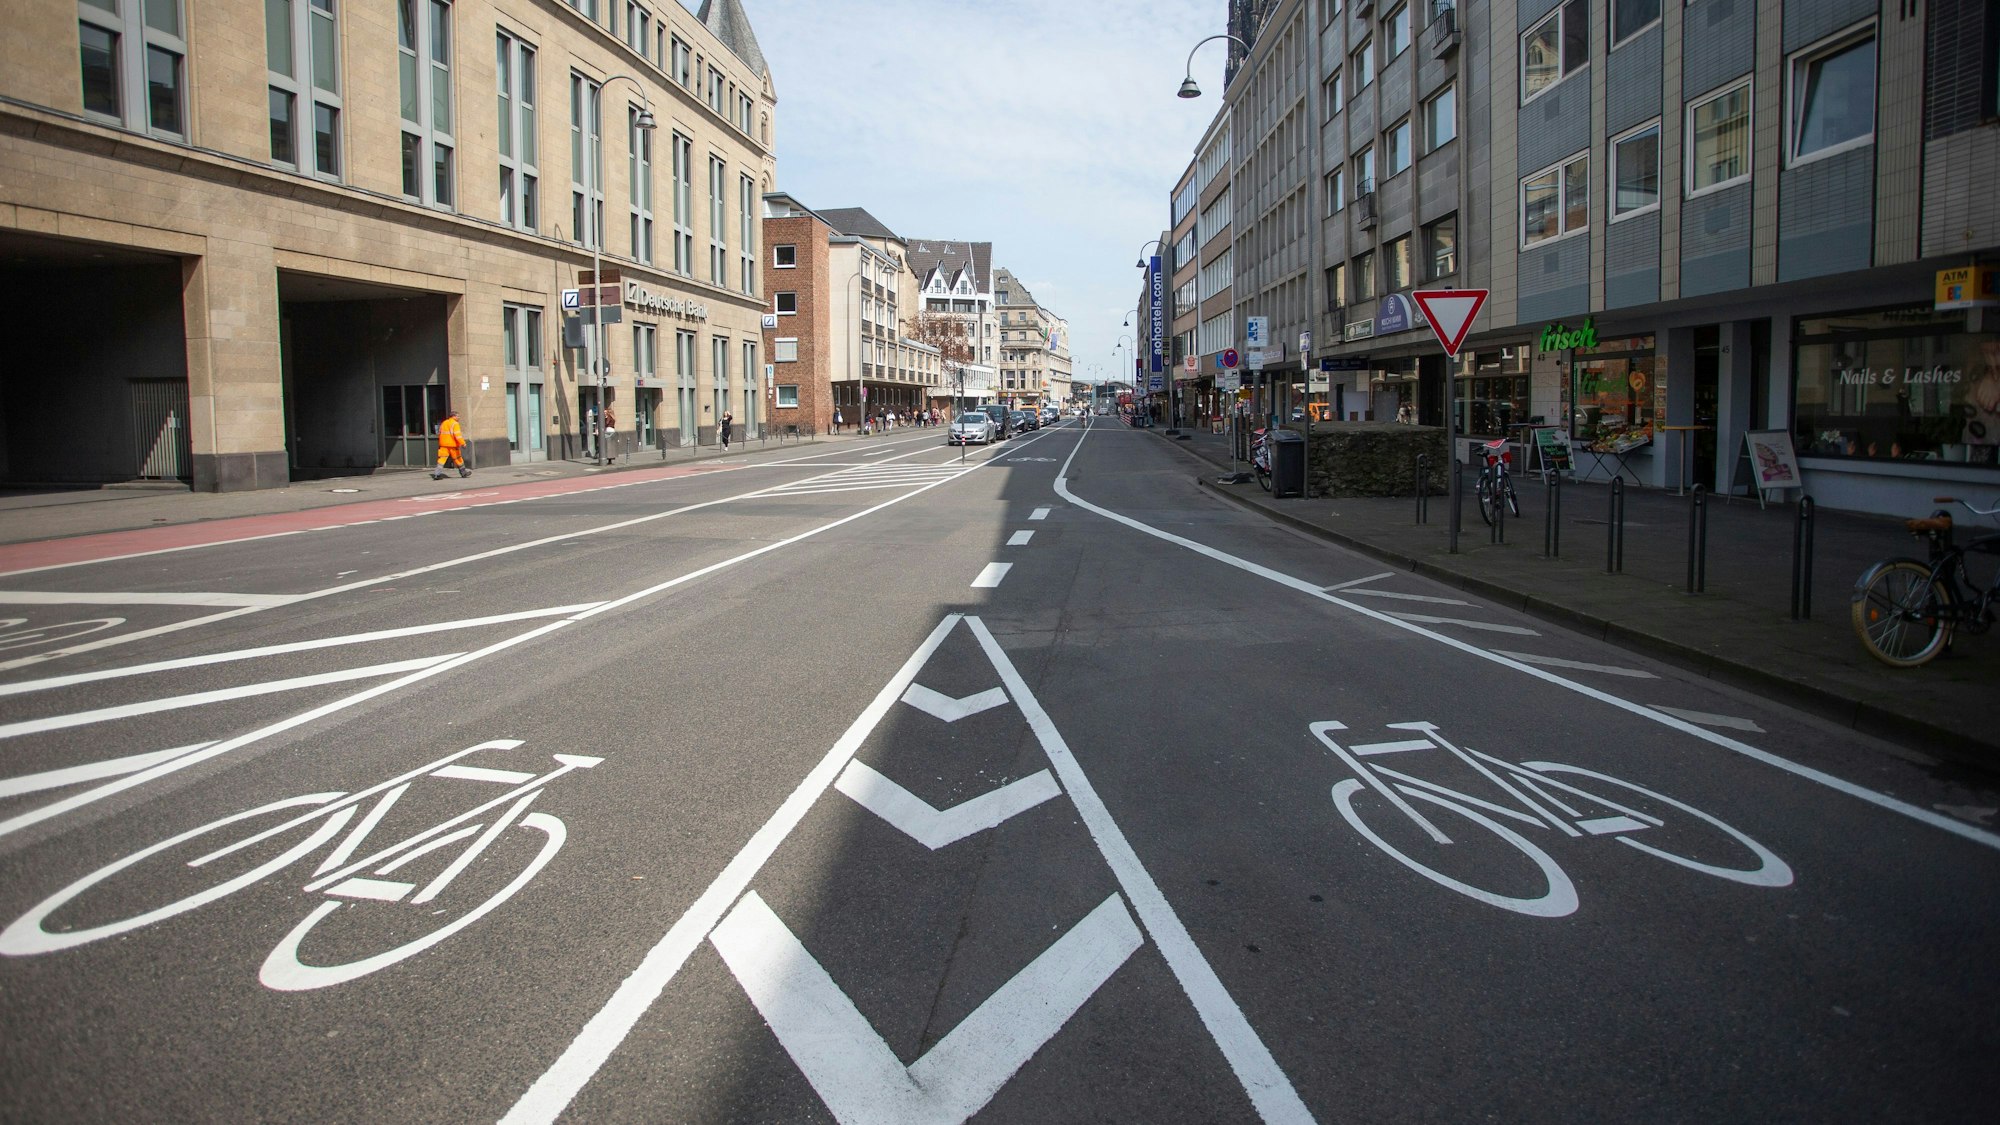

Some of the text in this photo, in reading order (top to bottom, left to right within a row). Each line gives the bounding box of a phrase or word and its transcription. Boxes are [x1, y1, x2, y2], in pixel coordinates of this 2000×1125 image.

[1943, 270, 1968, 282] ATM
[640, 288, 709, 318] Deutsche Bank
[1151, 272, 1162, 355] aohostels.com
[1539, 318, 1597, 352] frisch
[1537, 354, 1545, 362] 43
[1722, 345, 1730, 354] 45
[1840, 365, 1962, 385] Nails & Lashes
